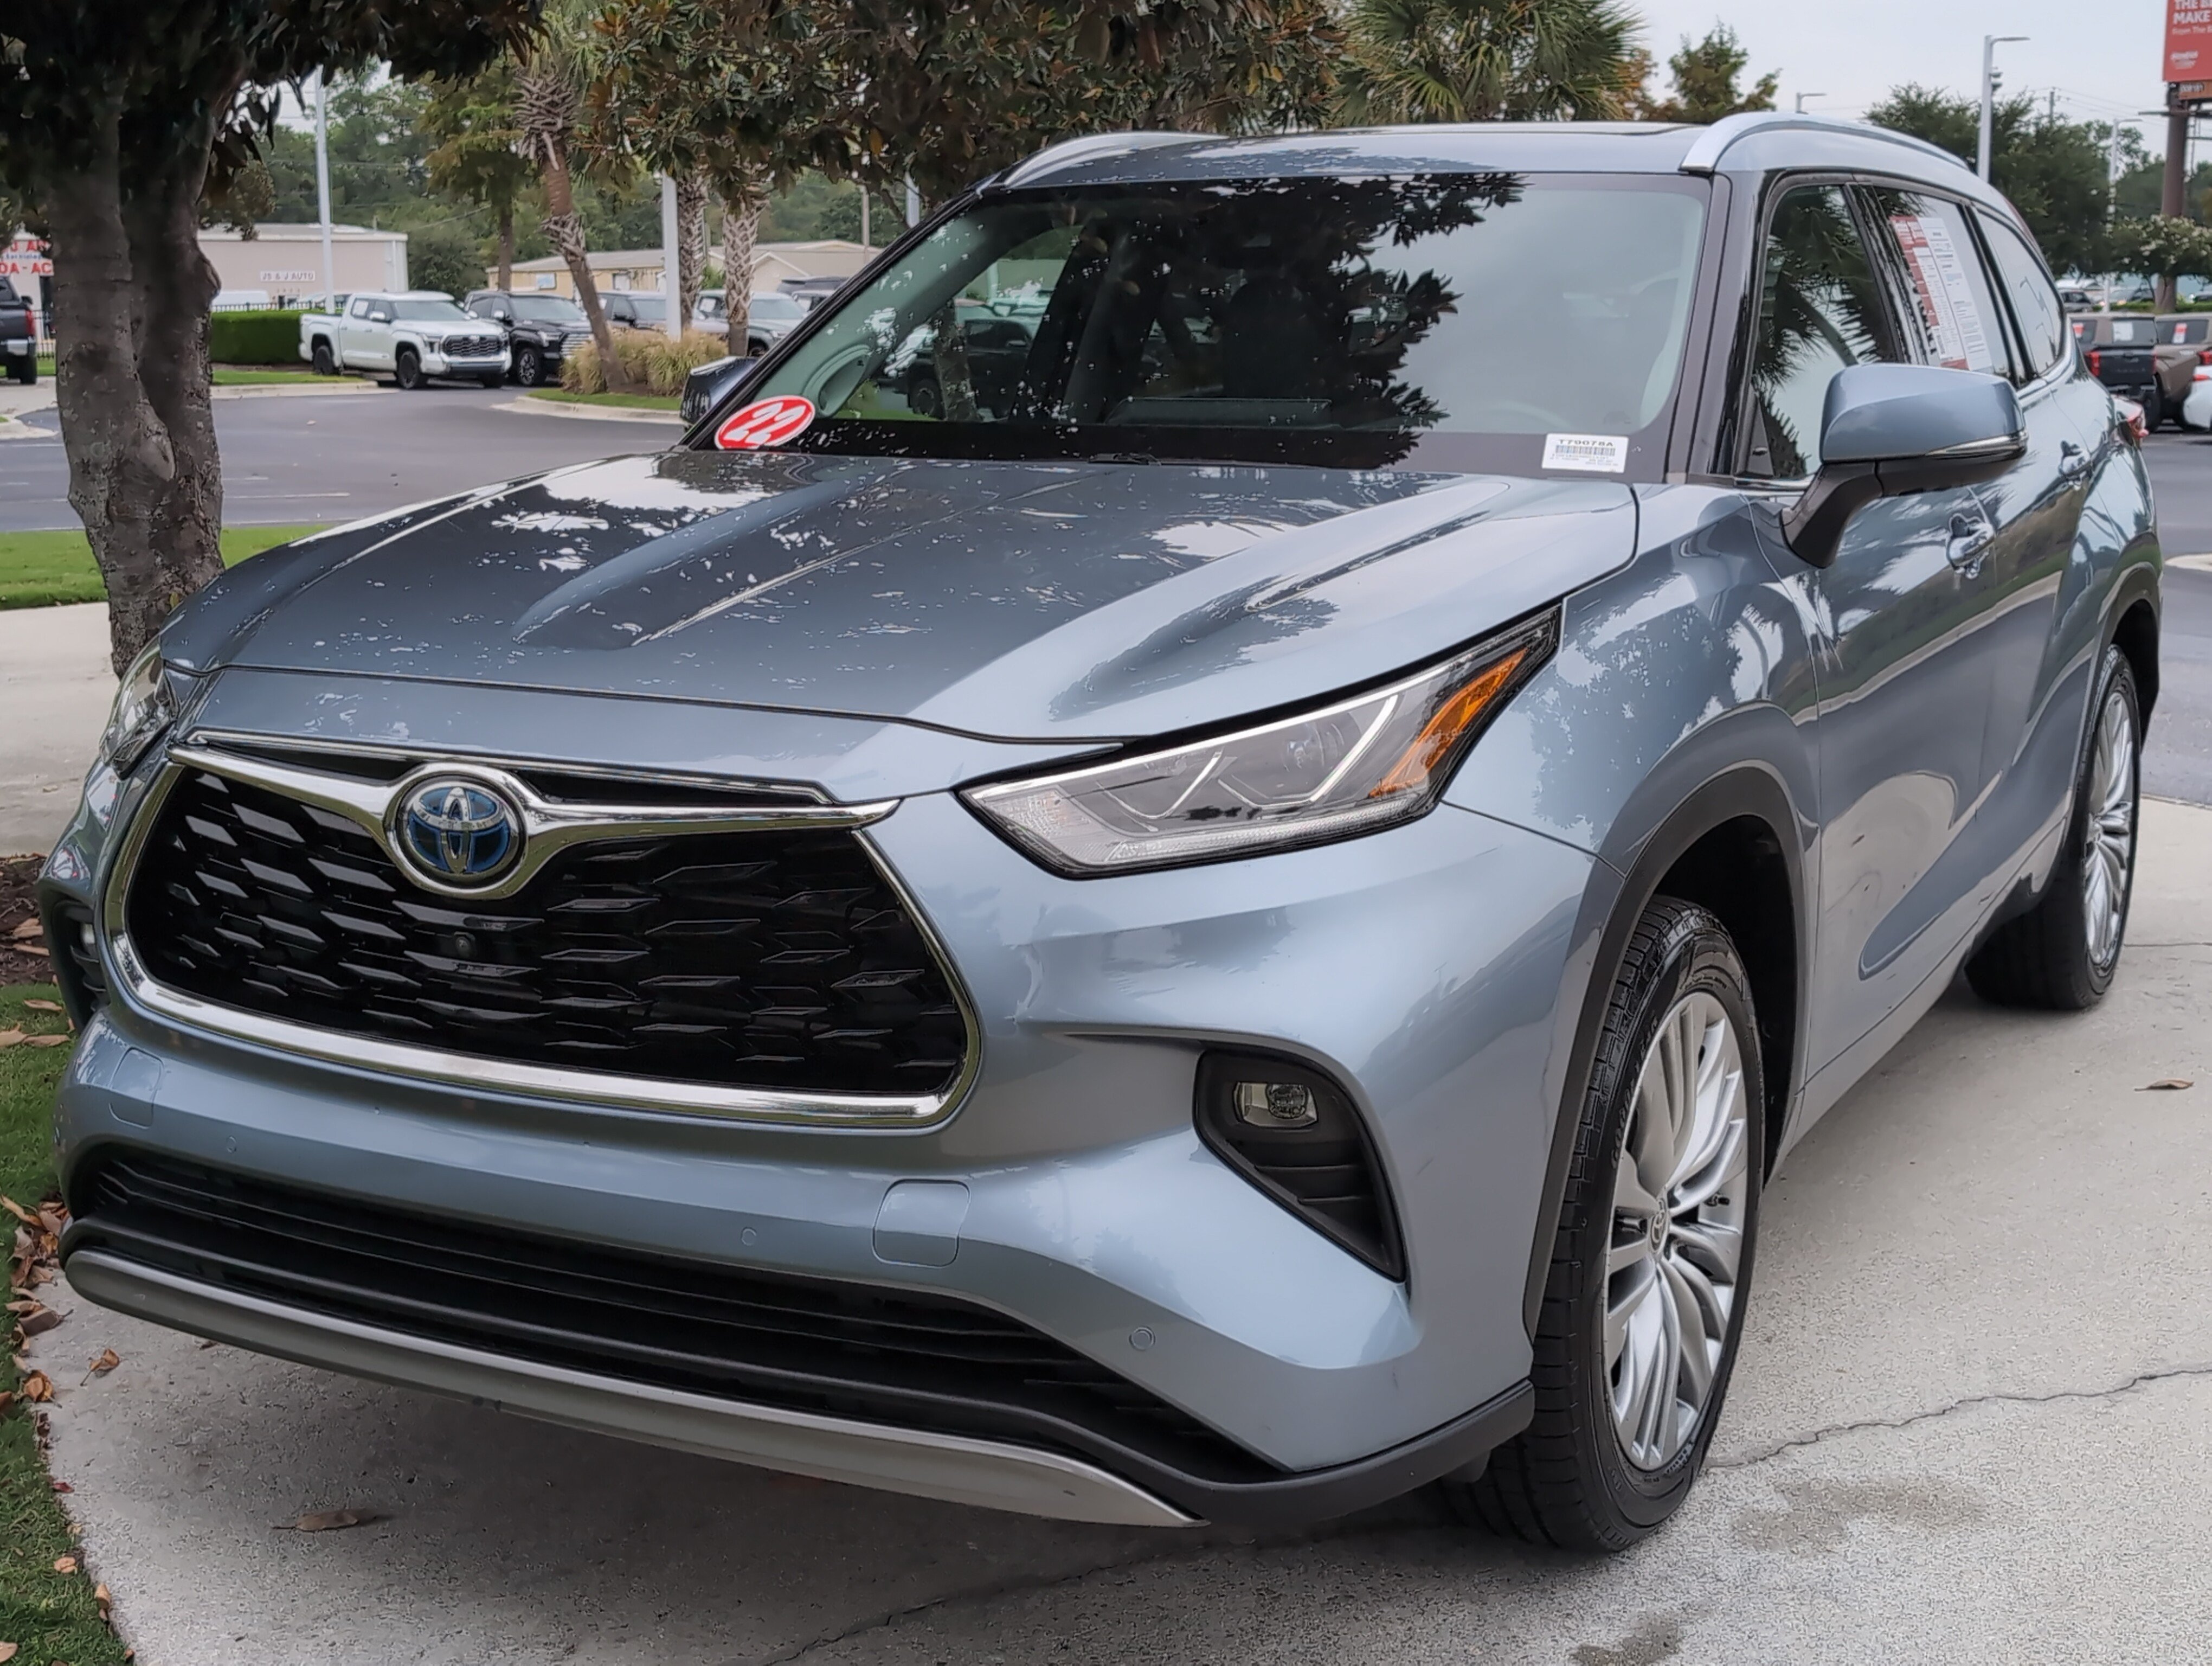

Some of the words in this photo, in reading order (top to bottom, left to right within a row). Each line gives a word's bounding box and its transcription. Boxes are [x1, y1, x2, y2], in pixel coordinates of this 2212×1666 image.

[2173, 11, 2210, 24] MAKE
[284, 272, 289, 280] J
[722, 401, 807, 445] 22
